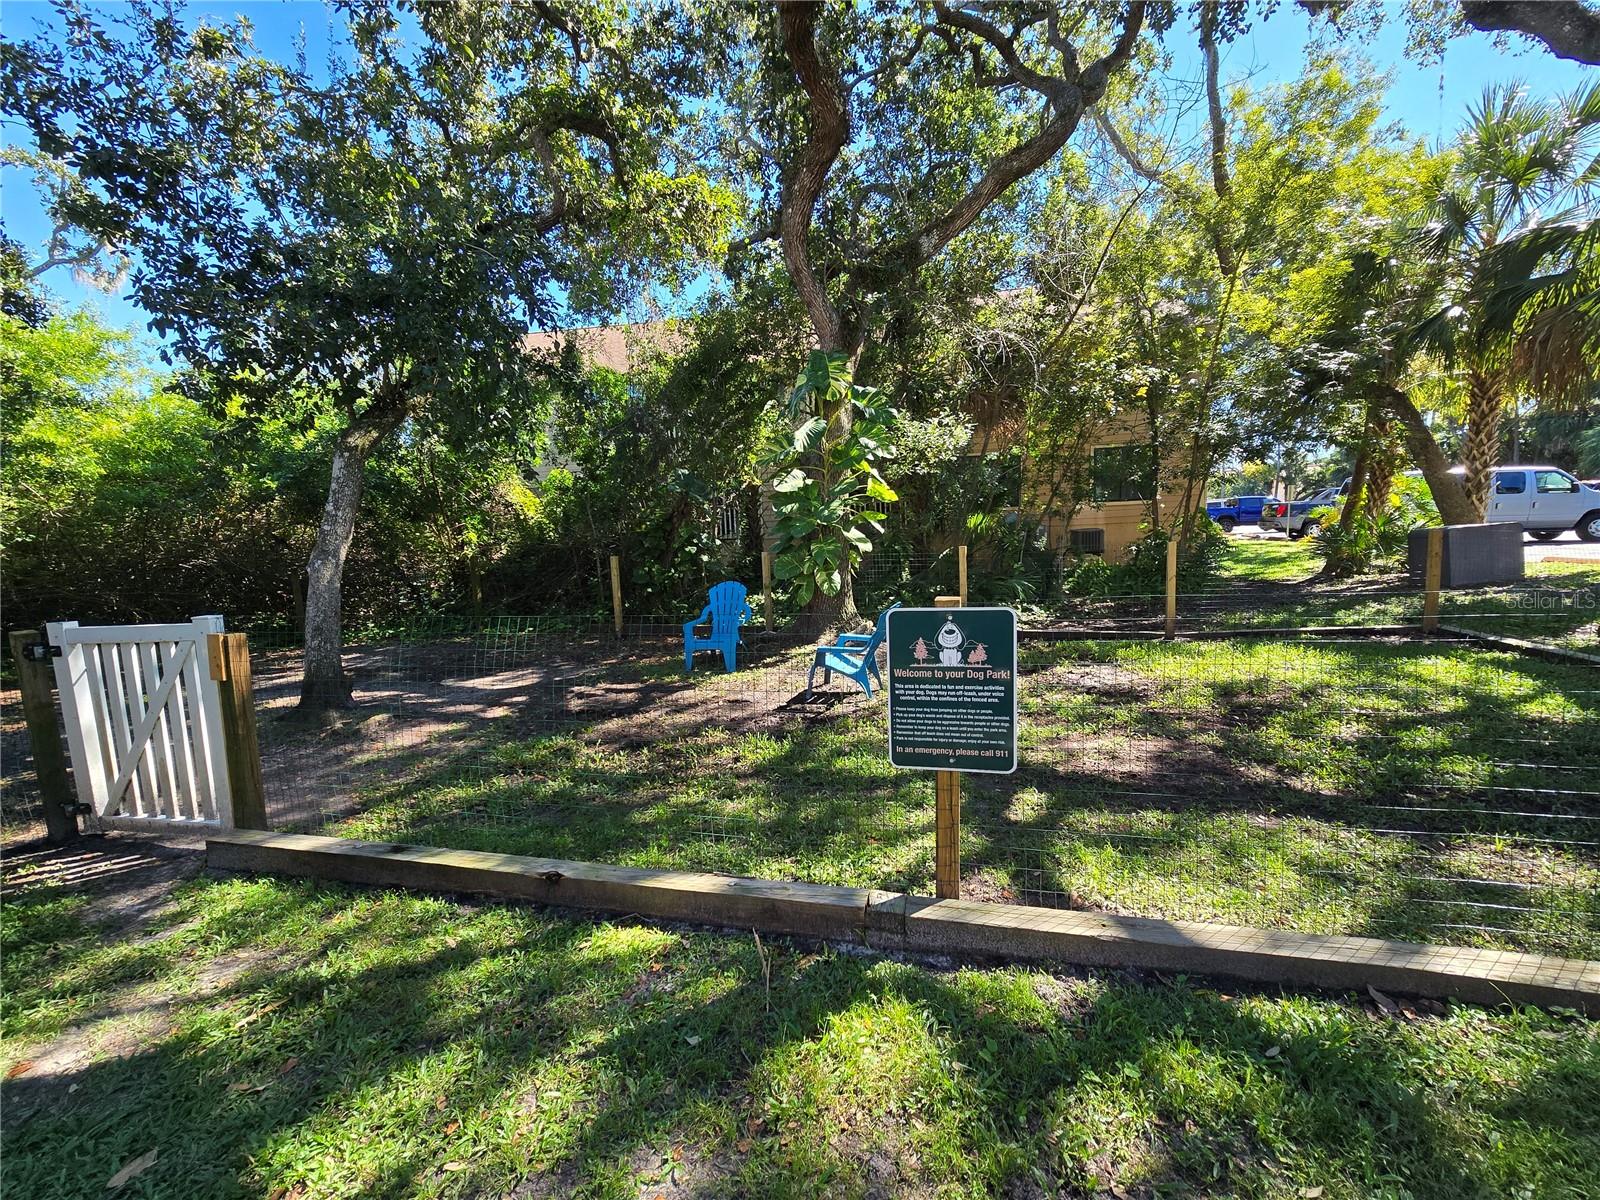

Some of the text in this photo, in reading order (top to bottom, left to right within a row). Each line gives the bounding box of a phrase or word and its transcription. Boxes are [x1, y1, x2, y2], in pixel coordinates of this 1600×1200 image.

[894, 669, 932, 677] Welcome
[946, 671, 964, 679] your
[967, 670, 984, 680] Dog
[987, 670, 1010, 678] Park!
[915, 747, 954, 755] emergency,
